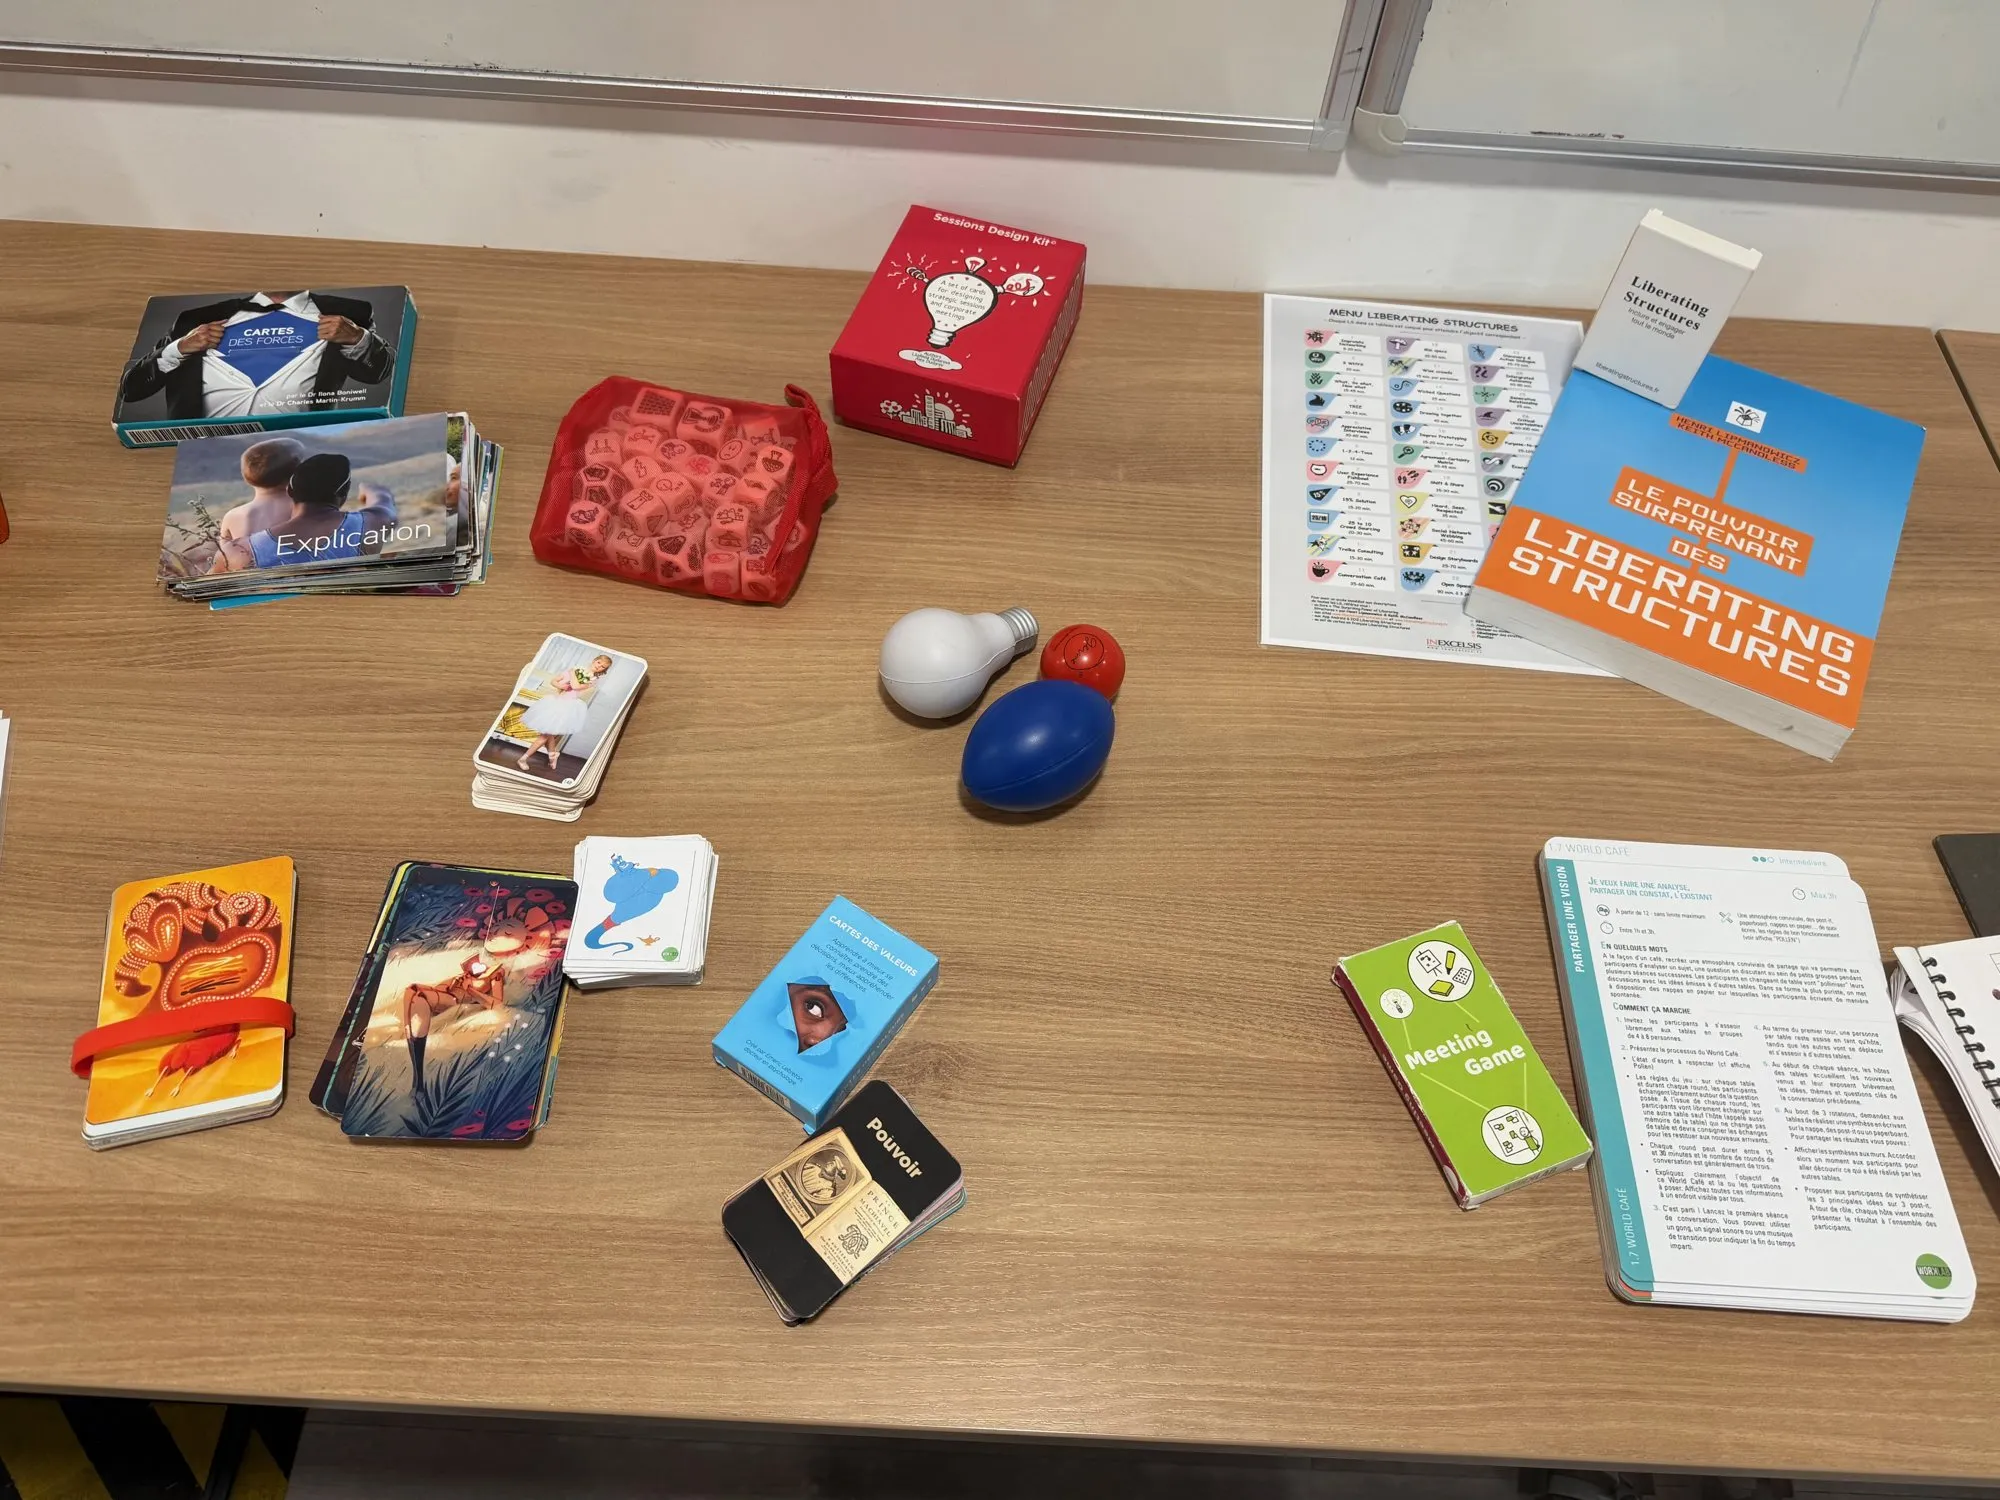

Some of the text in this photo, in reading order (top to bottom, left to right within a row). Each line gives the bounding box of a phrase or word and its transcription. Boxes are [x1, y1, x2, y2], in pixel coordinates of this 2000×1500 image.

[934, 213, 985, 232] Sessions
[988, 226, 1030, 242] Design
[928, 292, 985, 310] strategic sessions
[950, 290, 983, 303] designing
[970, 288, 986, 296] cards
[1631, 276, 1710, 318] Liberating
[935, 310, 965, 320] meetings
[944, 304, 976, 315] corporate
[1330, 308, 1362, 318] MENU
[1368, 312, 1439, 324] LIBERATING
[1443, 319, 1518, 332] STRUCTURES
[1624, 291, 1700, 330] Structures
[244, 326, 294, 336] CARTES
[1628, 308, 1650, 320] Inclure
[1660, 320, 1686, 336] engager
[1632, 317, 1675, 340] tout le monde
[228, 336, 304, 346] DES FORCES
[1594, 362, 1660, 393] liberatingstructures.fr
[316, 396, 366, 404] Martin-Krumm
[337, 388, 366, 396] Boniwell
[1676, 416, 1800, 464] HENRI LIPMANOWICZ
[1678, 422, 1796, 470] KEITH MCCANDLESS
[1628, 478, 1800, 550] LE POUVOIR
[276, 522, 432, 556] Explication
[1615, 492, 1802, 571] SURPRENANT
[1671, 540, 1726, 571] DES
[1338, 572, 1372, 580] Conversation
[1524, 518, 1856, 664] LIBERATING
[1508, 546, 1851, 696] STRUCTURES
[1426, 639, 1482, 650] INEXCELSIS
[1566, 844, 1602, 856] WORLD
[1779, 857, 1826, 868] Intermédiaire
[1588, 876, 1598, 886] JE
[1600, 879, 1618, 887] VEUX
[1620, 880, 1638, 888] FAIRE
[1640, 882, 1656, 890] UNE
[1590, 886, 1624, 896] PARTAGER
[1674, 890, 1713, 900] L'EXISTANT
[1810, 890, 1837, 900] Max 3h
[1556, 866, 1584, 973] PARTAGER UNE VISION
[830, 916, 918, 976] CARTES DES VALEURS
[832, 938, 863, 960] Apprendre
[1600, 941, 1611, 950] EN
[1614, 944, 1647, 952] QUELQUES
[826, 963, 834, 971] les
[854, 962, 878, 980] prendre
[877, 978, 888, 987] des
[840, 962, 856, 975] mieux
[856, 974, 895, 1000] appréhender
[1613, 1002, 1648, 1012] COMMENT
[1652, 1006, 1660, 1014] ÇA
[1404, 1030, 1493, 1070] Meeting
[1630, 1044, 1659, 1052] Présentez
[1464, 1044, 1526, 1076] Game
[866, 1117, 922, 1178] Pouvoir
[1804, 1186, 1832, 1195] Proposer
[1848, 1190, 1883, 1198] participants
[868, 1190, 900, 1230] PRINCE
[1615, 1188, 1640, 1265] 1.7 WORLD CAFÉ
